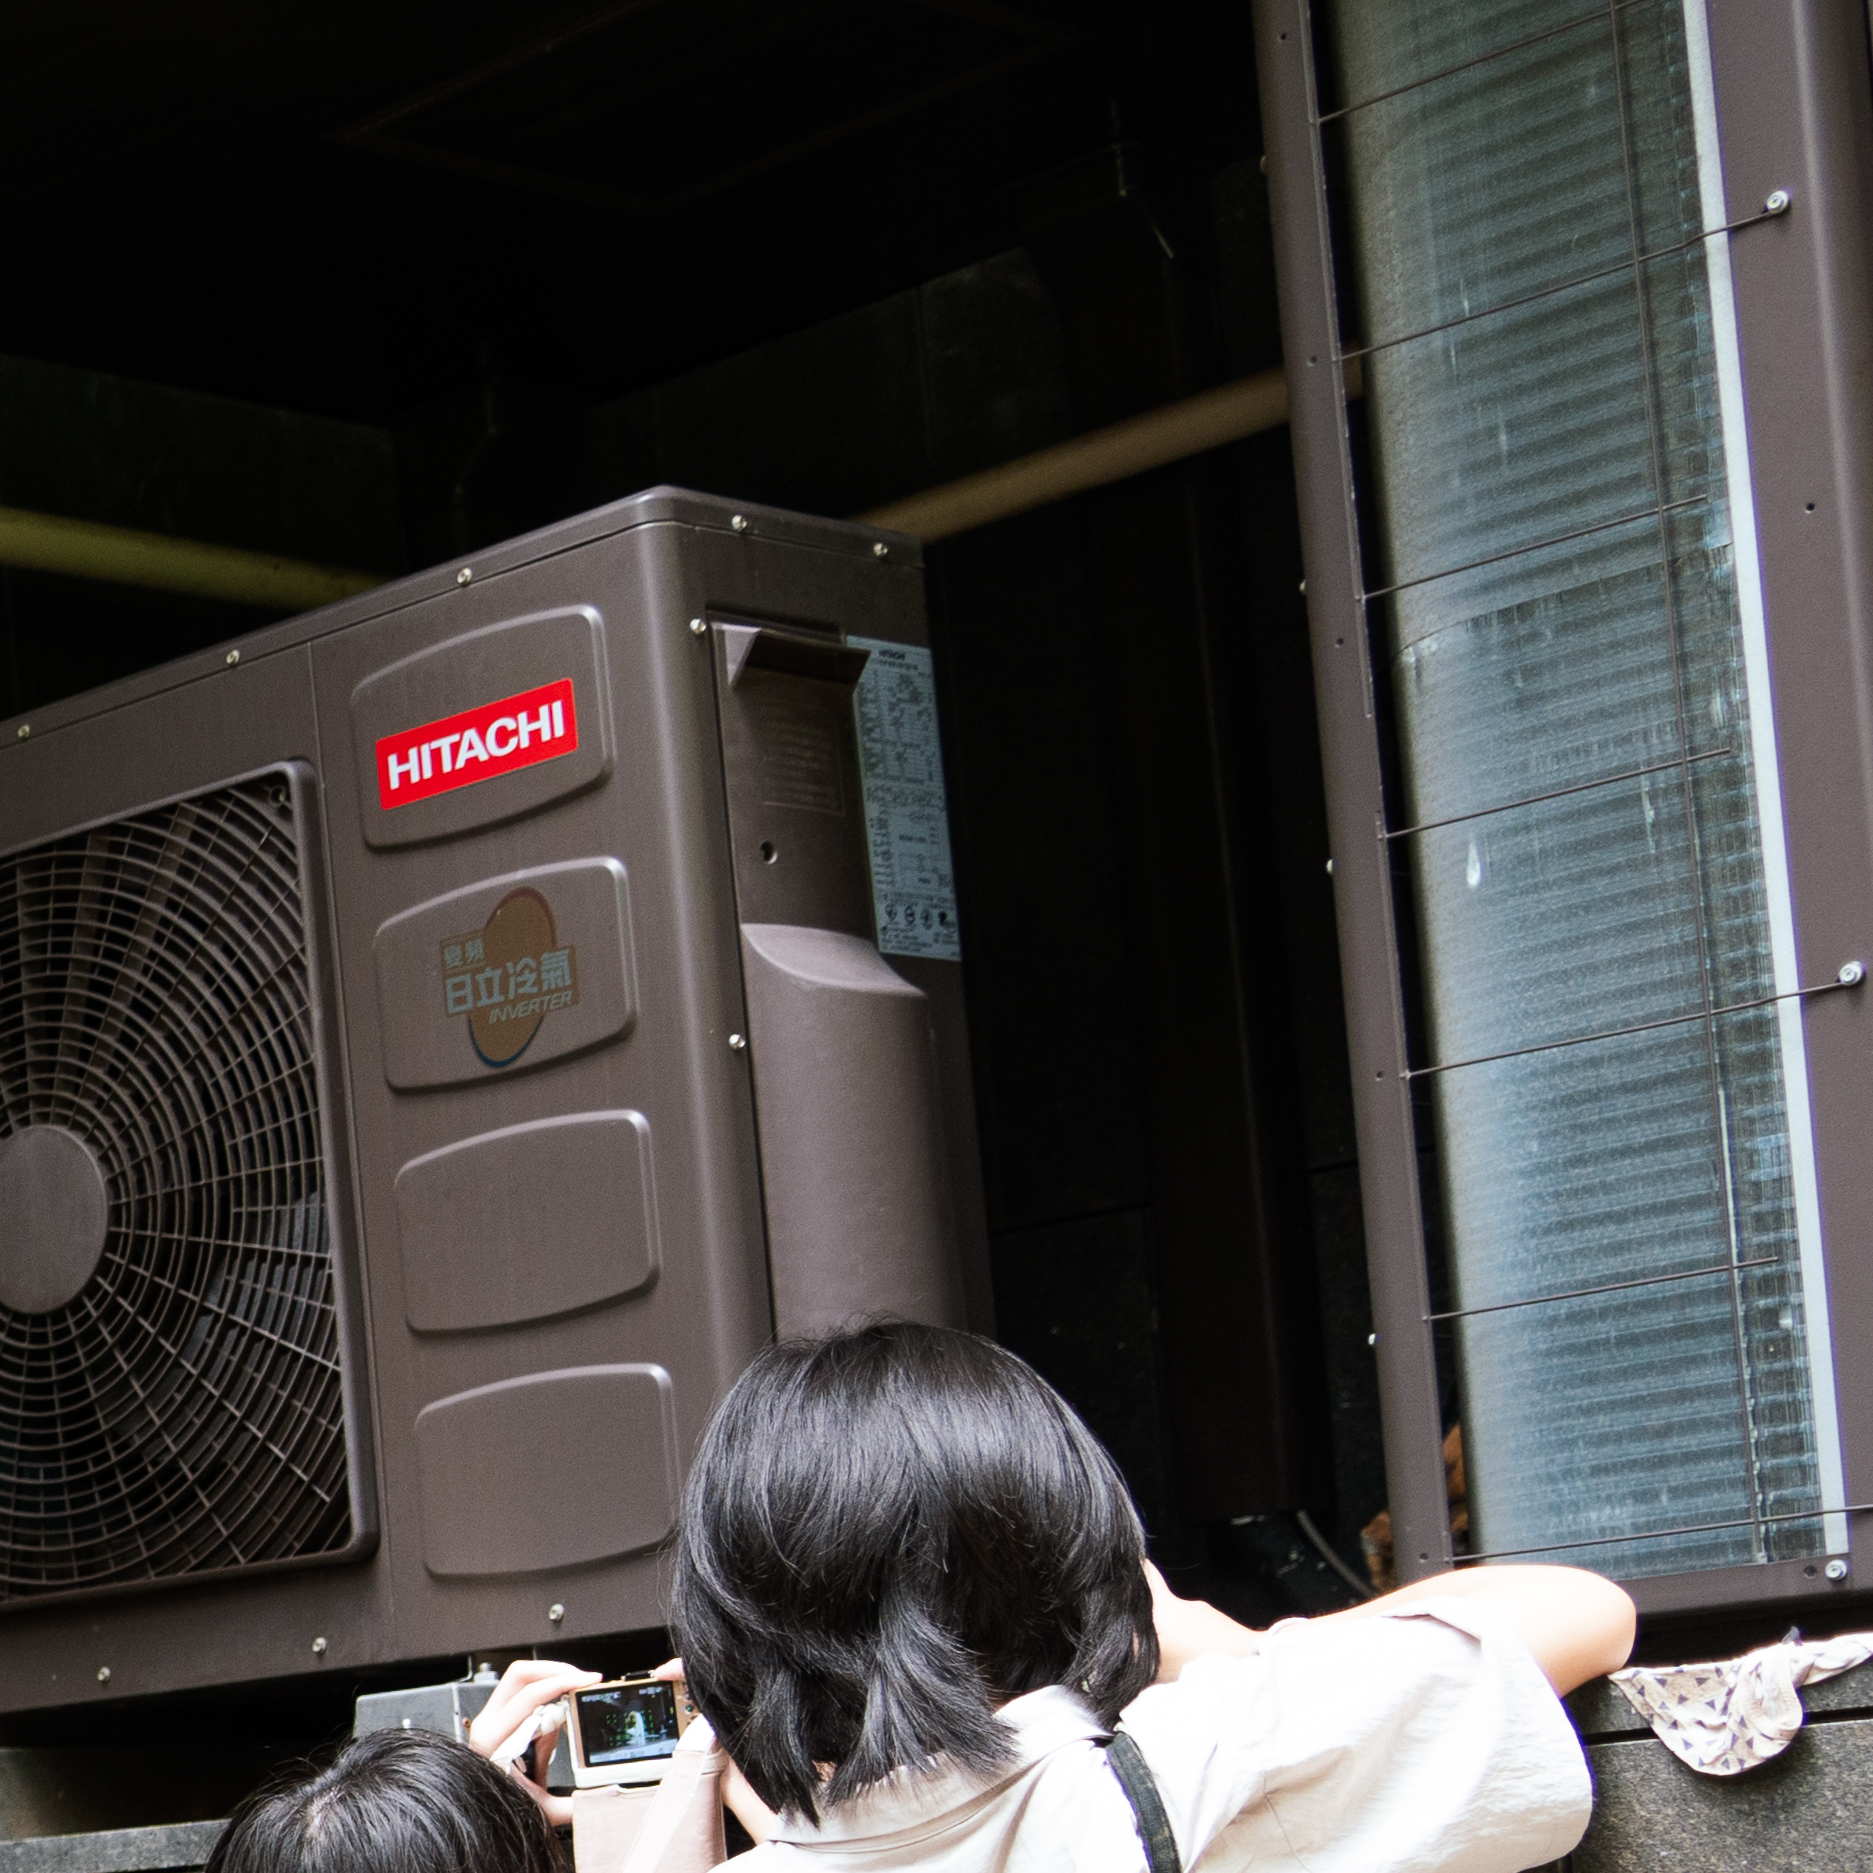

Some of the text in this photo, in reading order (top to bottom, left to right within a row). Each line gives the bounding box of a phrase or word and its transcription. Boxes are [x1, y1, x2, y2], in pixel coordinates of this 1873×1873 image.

[387, 699, 565, 791] HITACHI
[445, 949, 572, 1014] 日立冷氣
[488, 990, 573, 1025] INVERTER
